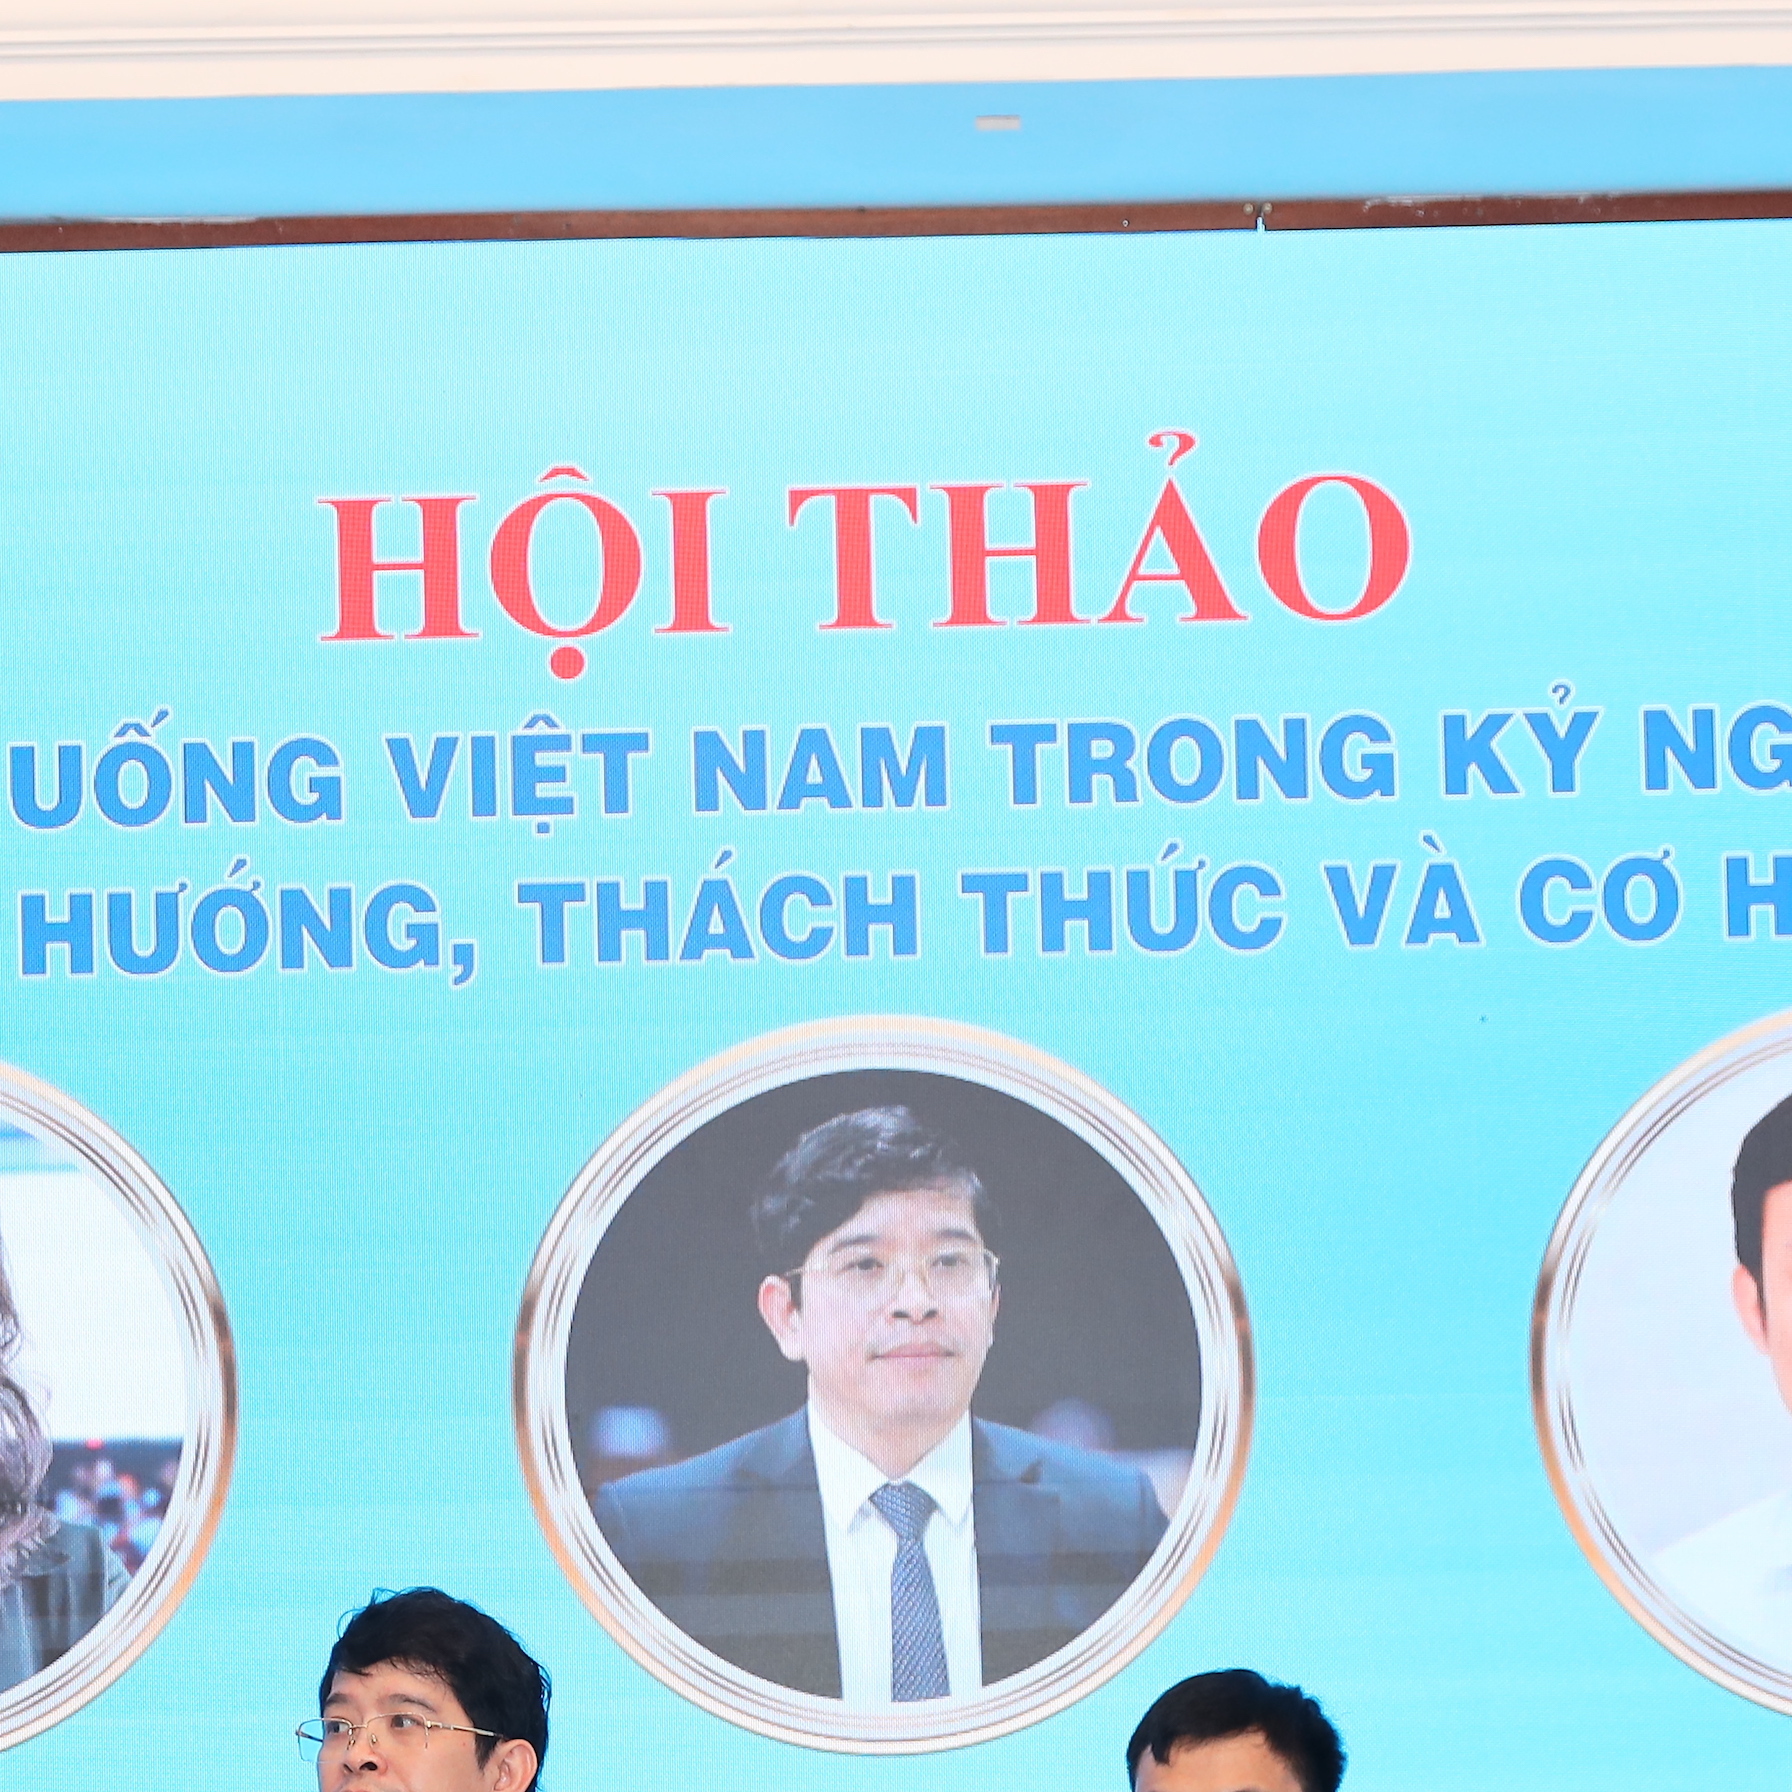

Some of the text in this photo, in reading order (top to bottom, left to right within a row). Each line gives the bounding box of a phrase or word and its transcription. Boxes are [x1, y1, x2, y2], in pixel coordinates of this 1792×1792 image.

[316, 430, 1413, 682] HỘI THẢO
[8, 706, 344, 829] UỐNG
[385, 710, 652, 836] VIỆT
[692, 720, 947, 815] NAM
[988, 710, 1398, 808] TRONG
[1439, 680, 1599, 797] KỶ
[18, 856, 477, 987] HƯỚNG,
[517, 850, 918, 965] THÁCH
[960, 842, 1285, 956] THỨC
[1323, 832, 1482, 948] VÀ
[1517, 847, 1681, 945] CƠ
